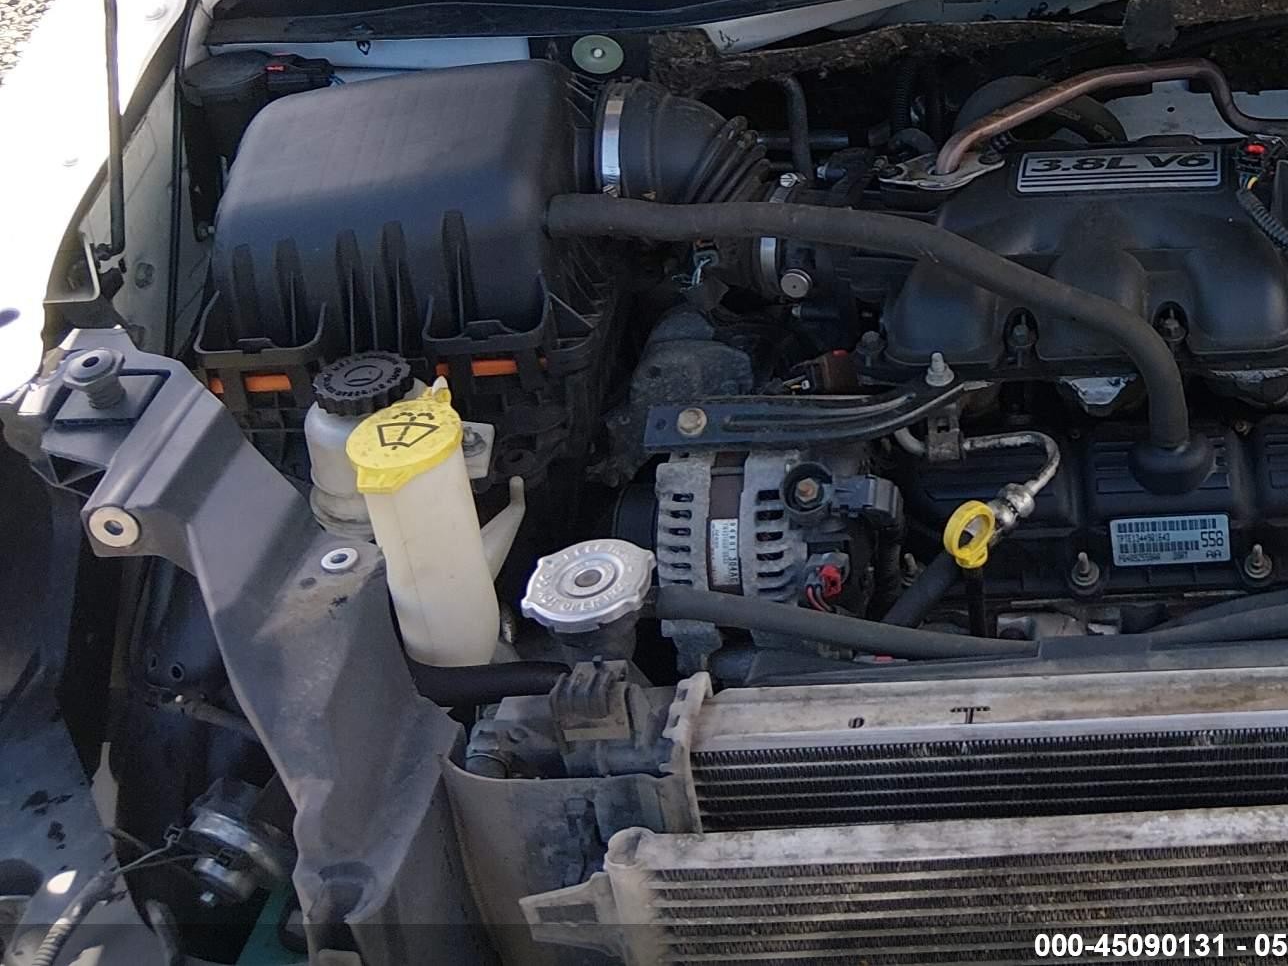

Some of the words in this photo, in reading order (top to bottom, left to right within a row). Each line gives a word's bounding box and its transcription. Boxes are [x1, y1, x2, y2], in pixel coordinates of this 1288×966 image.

[1031, 156, 1137, 173] 3.8L
[1145, 153, 1211, 171] V6
[1200, 529, 1225, 548] 558
[1205, 549, 1222, 559] AA
